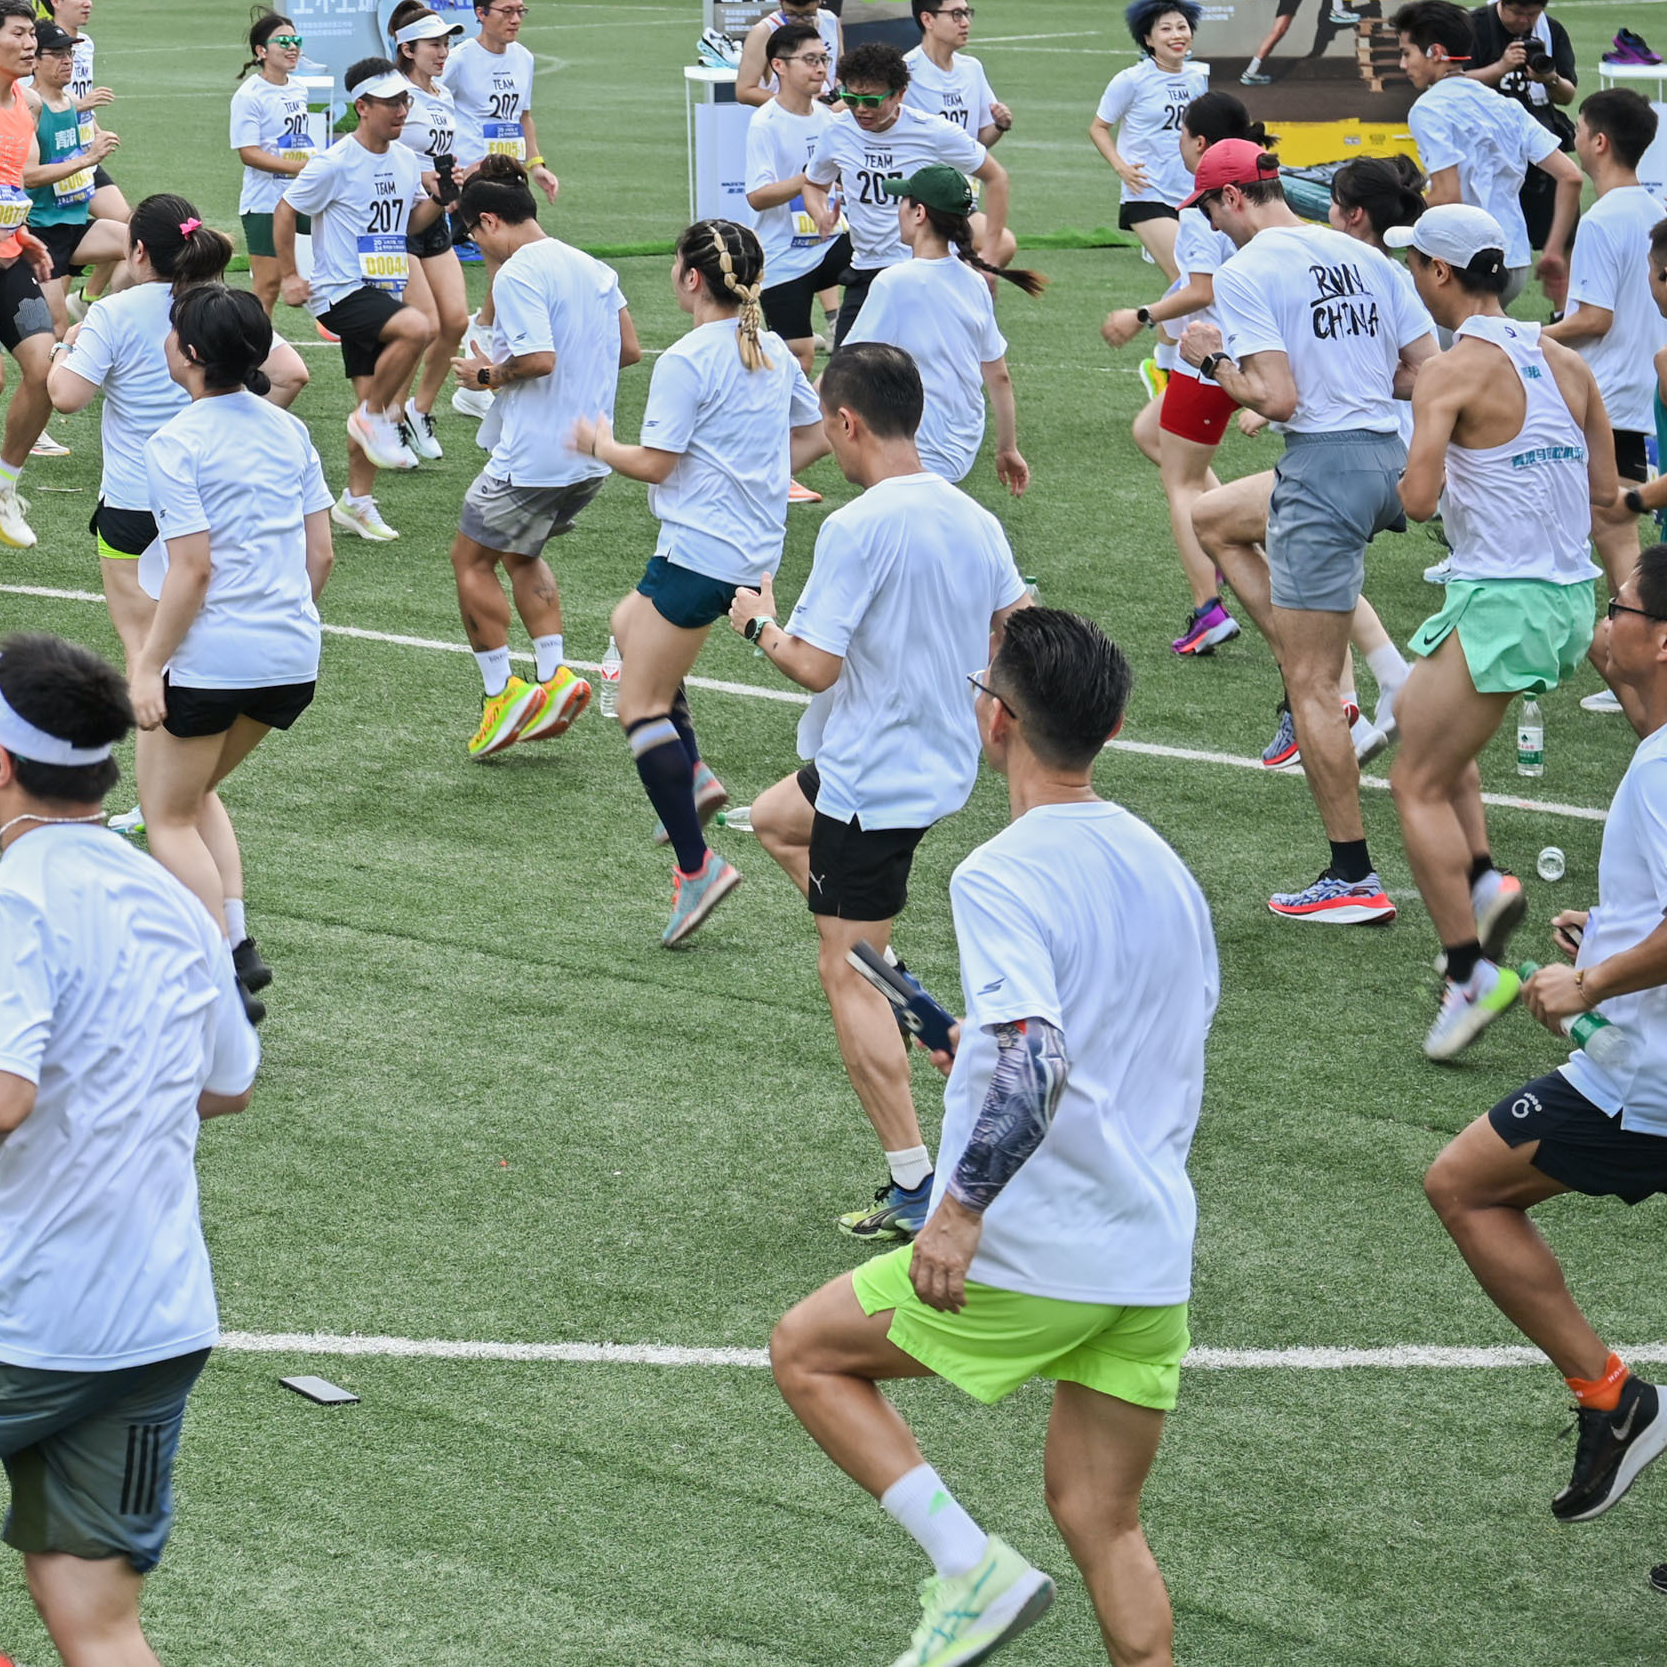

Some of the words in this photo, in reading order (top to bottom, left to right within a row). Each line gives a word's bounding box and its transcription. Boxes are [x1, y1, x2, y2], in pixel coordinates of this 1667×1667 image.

[493, 79, 516, 91] TEAM
[1168, 89, 1191, 101] TEAM
[489, 93, 520, 120] 207
[942, 94, 963, 107] TEAM
[424, 129, 454, 157] 207
[864, 154, 893, 169] TEAM
[374, 181, 397, 195] TEAM
[857, 171, 903, 205] 207
[367, 199, 404, 233] 207
[1309, 263, 1366, 297] RUN
[1313, 302, 1380, 340] CHINA
